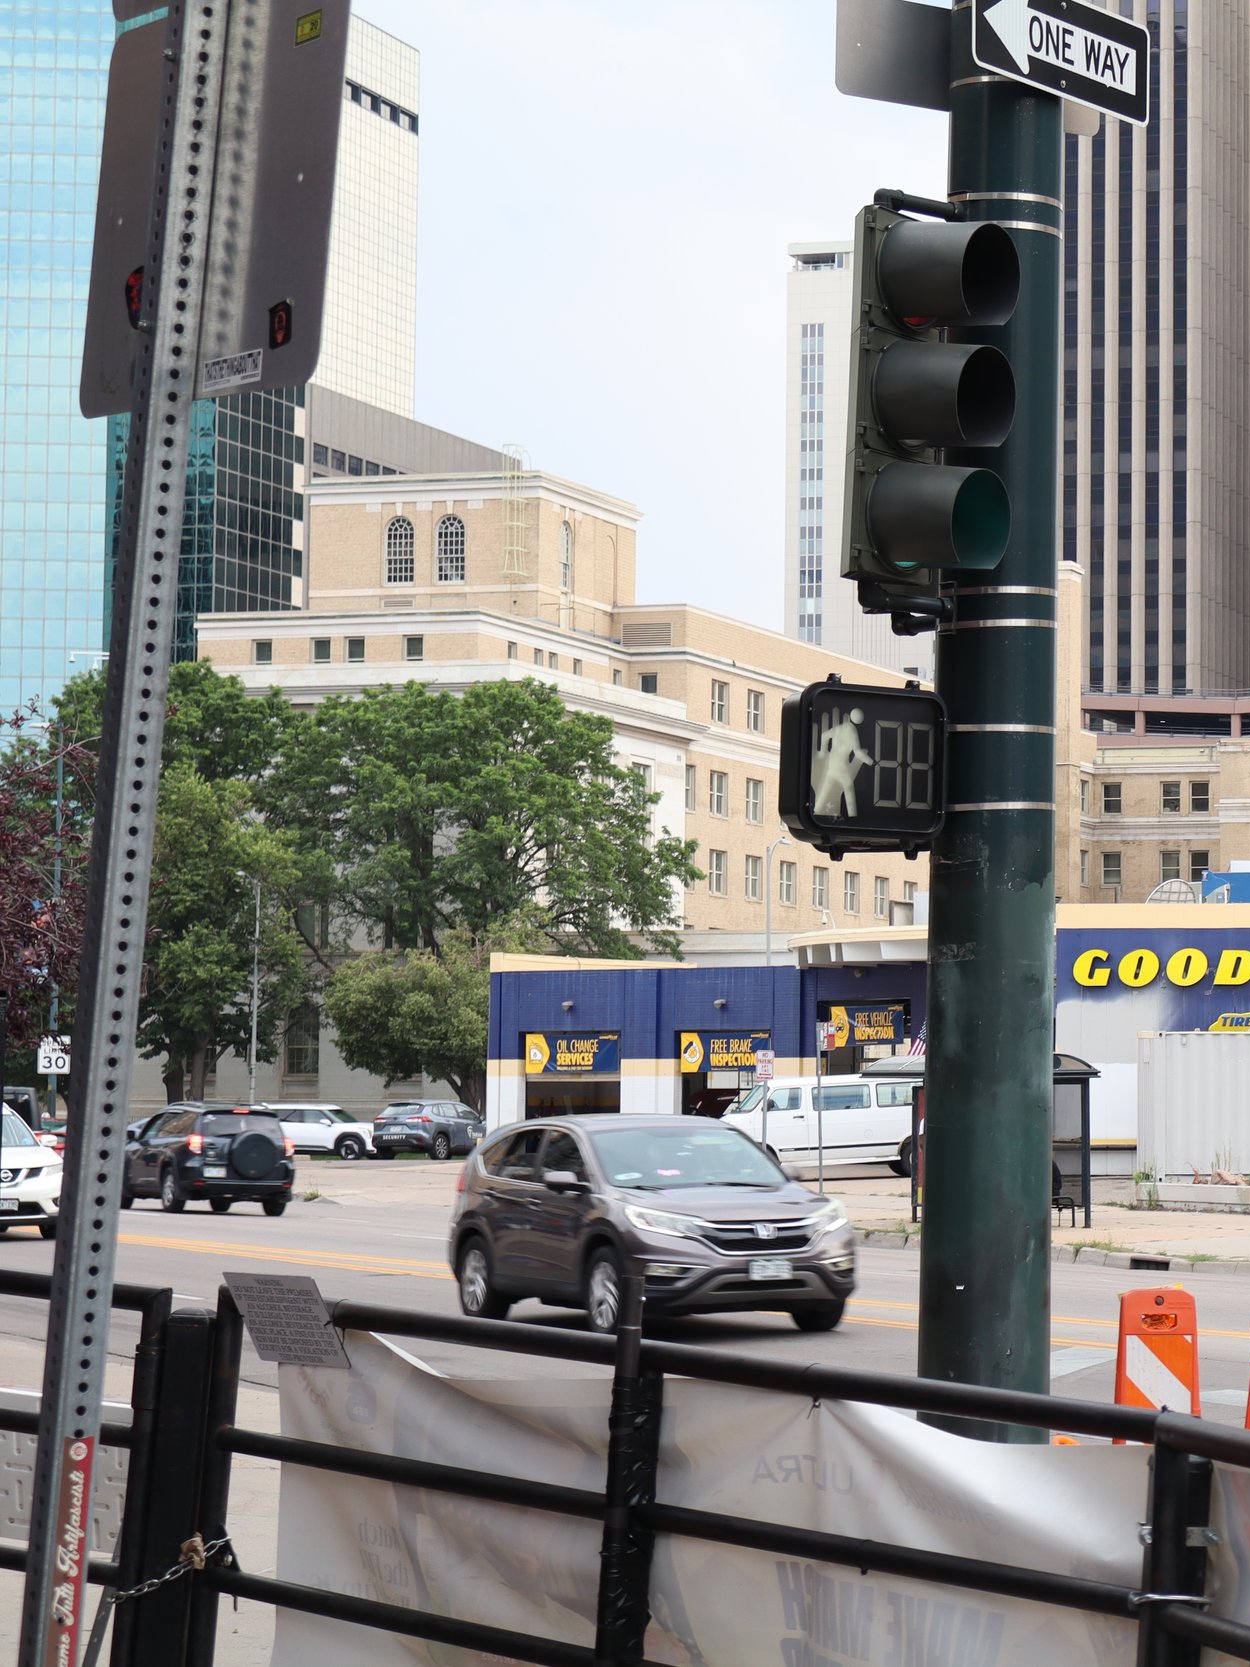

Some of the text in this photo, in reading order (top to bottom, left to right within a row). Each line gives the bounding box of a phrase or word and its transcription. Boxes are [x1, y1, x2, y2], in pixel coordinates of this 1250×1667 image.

[1029, 15, 1130, 85] ONE WAY
[855, 1012, 893, 1026] FREE VEHICLE
[854, 1026, 894, 1040] INSPECTION
[556, 1039, 599, 1052] OIL CHANGE
[710, 1039, 752, 1052] FREE BRAKE
[42, 1056, 66, 1069] 30
[556, 1052, 593, 1065] SERVICES
[710, 1053, 757, 1066] INSPECTION
[52, 1582, 75, 1626] Tutti
